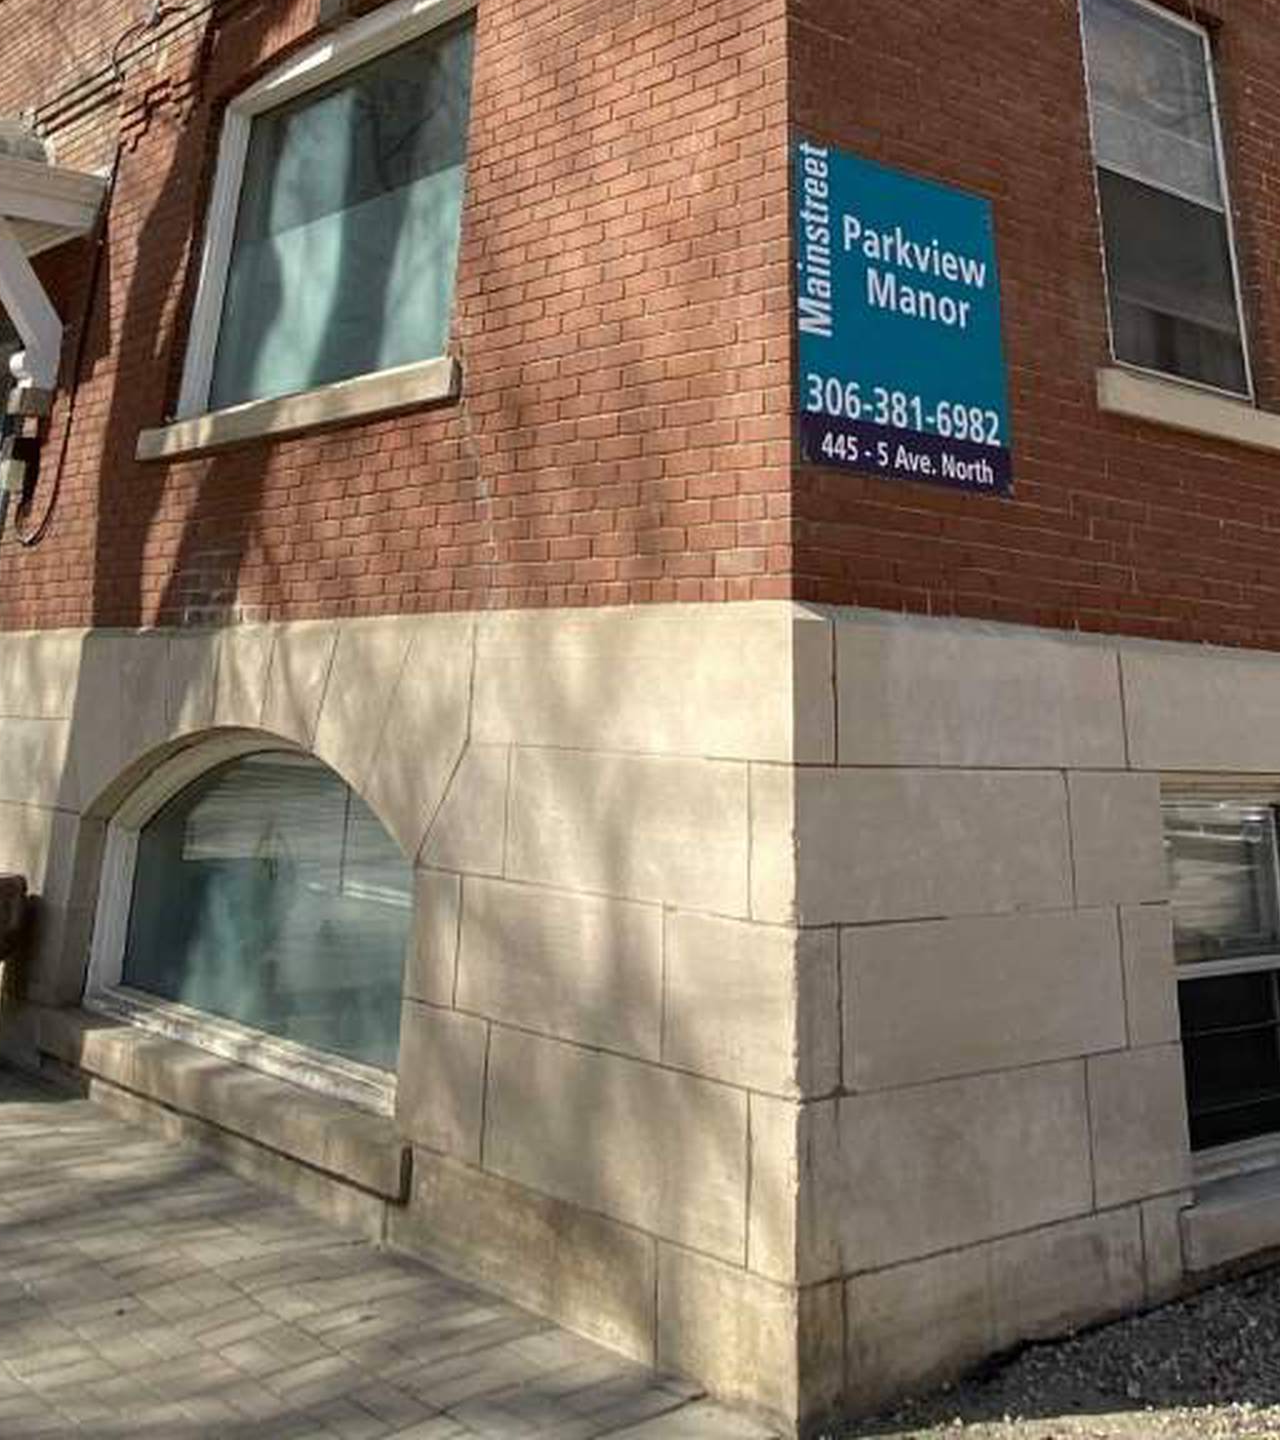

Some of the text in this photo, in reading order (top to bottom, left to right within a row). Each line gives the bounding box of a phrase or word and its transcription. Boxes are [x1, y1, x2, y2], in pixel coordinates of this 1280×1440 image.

[797, 141, 833, 338] Mainstreet
[842, 213, 987, 290] Parkview
[866, 266, 971, 329] Manor
[806, 372, 1002, 448] 306-381-6982
[820, 431, 859, 462] 445
[876, 440, 889, 467] 5
[894, 444, 937, 476] Ave.
[941, 451, 995, 486] North
